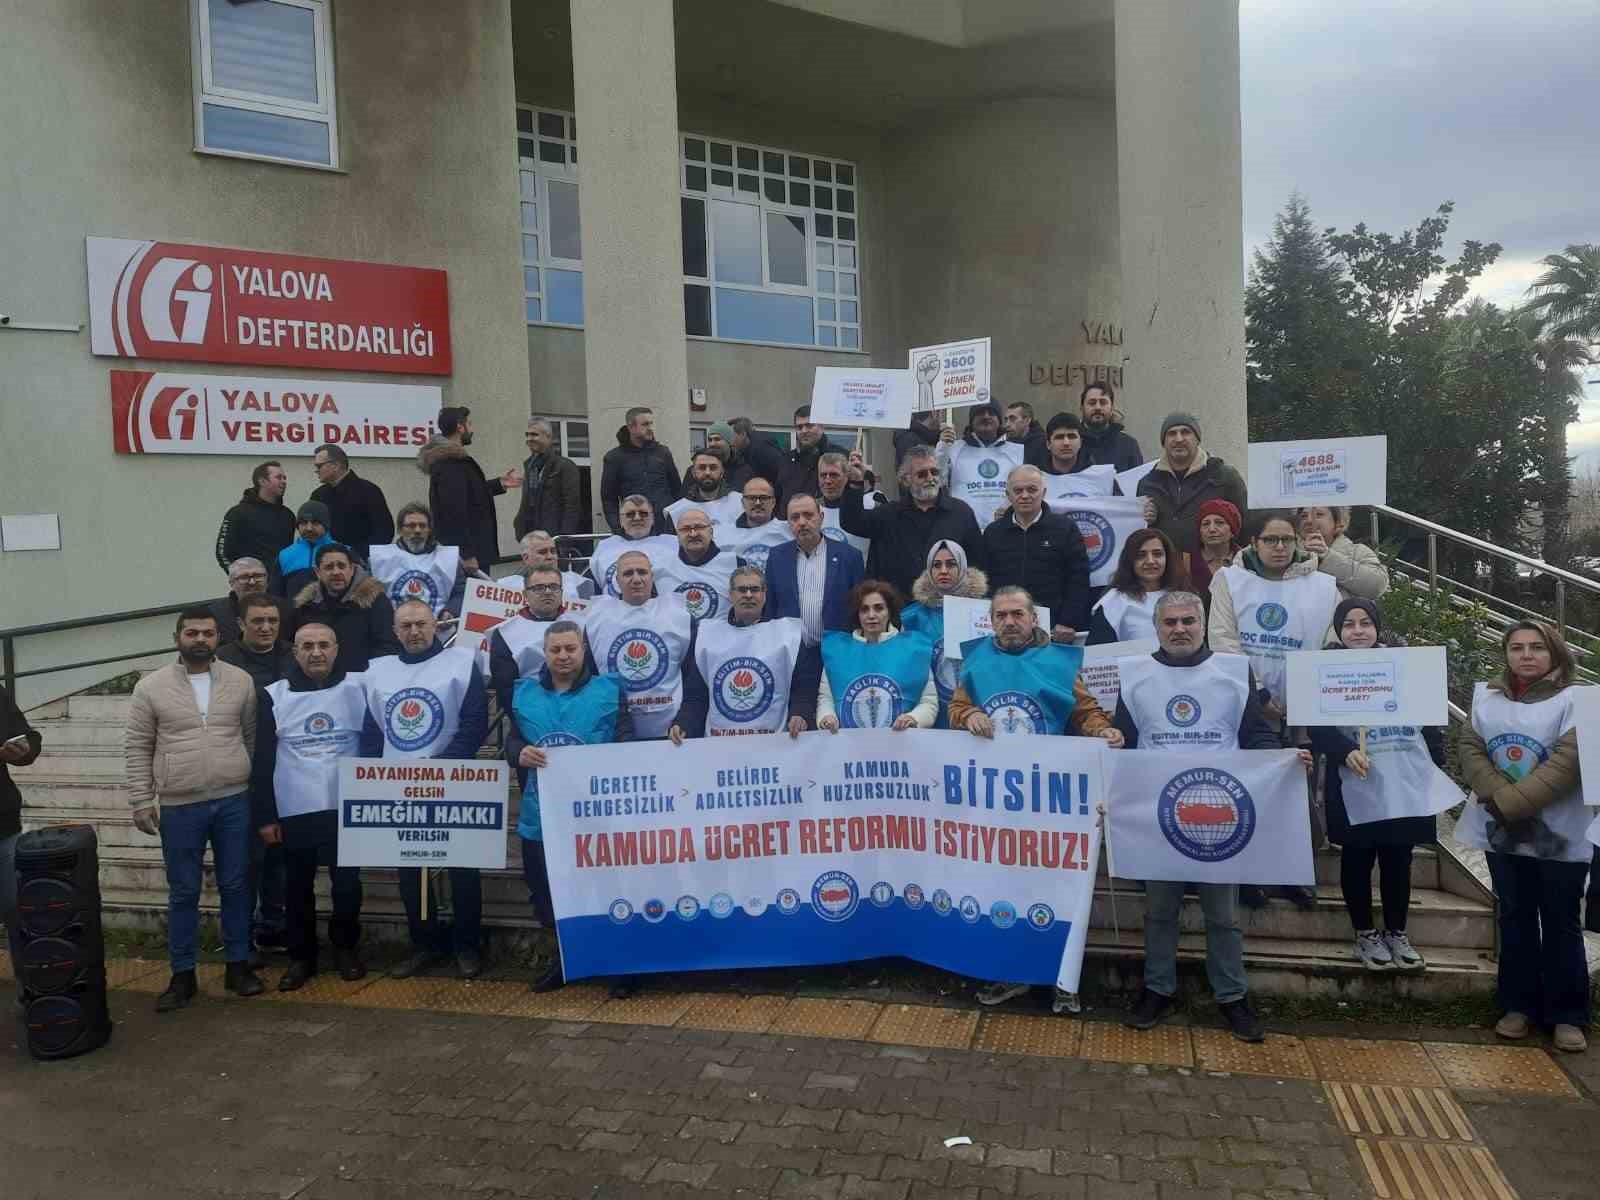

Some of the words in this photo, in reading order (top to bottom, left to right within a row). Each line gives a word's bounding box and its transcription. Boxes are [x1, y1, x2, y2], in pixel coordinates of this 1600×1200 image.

[232, 265, 334, 302] YALOVA
[238, 315, 434, 357] DEFTERDARLIĞI
[1080, 319, 1123, 346] YAL
[944, 355, 975, 369] 3600
[944, 373, 976, 385] HEMEN
[1029, 361, 1123, 388] DEFTER
[220, 388, 339, 415] YALOVA
[222, 416, 315, 443] VERGİ
[323, 418, 435, 446] DAİRESİ
[1299, 454, 1335, 466] 4688
[356, 766, 446, 783] DAYANIŞMA
[451, 764, 498, 782] AİDATI
[716, 766, 780, 787] GELİRDE
[844, 760, 910, 779] KAMUDA
[590, 775, 657, 795] ÜCRETTE
[823, 781, 931, 802] HUZURSUZLUK
[943, 759, 1089, 815] BİTSİN!
[573, 795, 675, 818] DENGESİZLİK
[696, 785, 804, 811] ADALETSİZLİK
[351, 801, 427, 823] EMEĞİN
[434, 806, 496, 825] HAKKI
[398, 830, 450, 842] VERİLSİN
[575, 827, 696, 868] KAMUDA
[704, 820, 791, 861] ÜCRET
[799, 815, 927, 854] REFORMU
[934, 818, 1089, 871] İSTİYORUZ!
